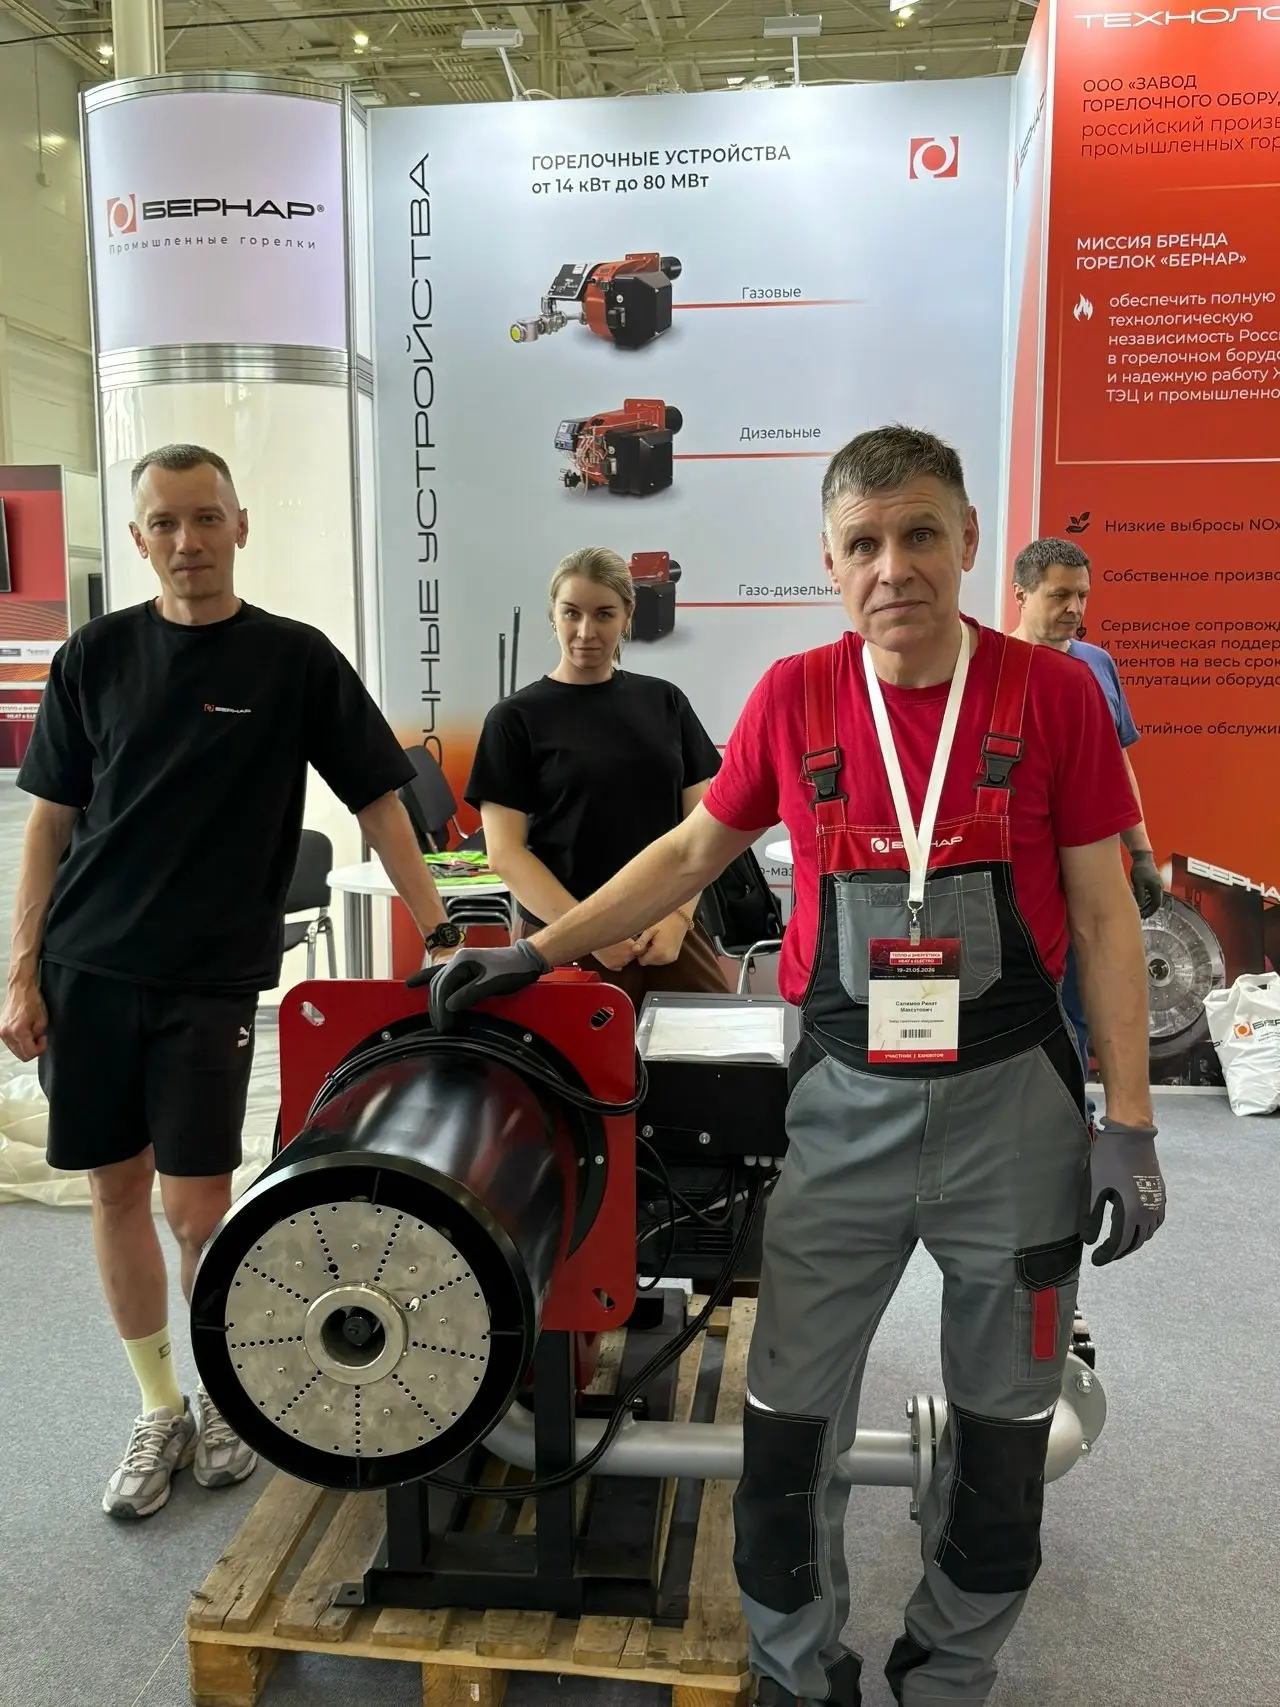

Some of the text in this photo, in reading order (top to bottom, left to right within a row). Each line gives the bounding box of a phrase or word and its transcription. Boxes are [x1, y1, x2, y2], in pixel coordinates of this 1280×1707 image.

[1083, 75, 1197, 93] ООО «ЗАВОД
[1083, 91, 1280, 113] ГОРЕЛОЧНОГО ОБОРУ
[1082, 116, 1204, 140] российский
[1081, 136, 1280, 160] промышленных гор
[532, 144, 791, 171] ГОРЕЛОЧНЫЕ УСТРОЙСТВА
[532, 173, 709, 194] от 14 кВт до 80 МВт
[109, 234, 316, 255] Промышленные горелки
[1077, 232, 1228, 251] МИССИЯ БРЕНДА
[1076, 252, 1247, 270] ГОРЕЛОК «БЕРНАР»
[742, 286, 801, 300] Газовые
[1110, 292, 1275, 308] обеспечить полную
[1109, 311, 1253, 327] технологическую
[1109, 329, 1280, 346] независимость Росс
[1108, 354, 1116, 365] в
[1121, 351, 1220, 367] горелочном
[1107, 373, 1116, 383] и
[1122, 371, 1207, 386] надежную
[1212, 367, 1268, 385] работу
[1106, 389, 1280, 404] ТЭЦ и промышленно
[740, 426, 821, 442] Дизельные
[406, 153, 442, 767] ОЧНЫЕ УСТРОЙСТВА
[1105, 520, 1165, 532] Низкие
[1170, 518, 1244, 534] выбросы
[1103, 569, 1209, 583] Собственное
[738, 584, 840, 597] Газо-дизельн
[1101, 619, 1190, 635] Сервисное
[1101, 638, 1280, 652] и техническая поддер
[1114, 657, 1174, 668] лиентов
[1181, 657, 1198, 668] на
[1204, 656, 1240, 668] весь
[1120, 674, 1211, 688] сплуатации
[1137, 721, 1280, 737] нтийное обслужи
[892, 836, 963, 849] БНАР
